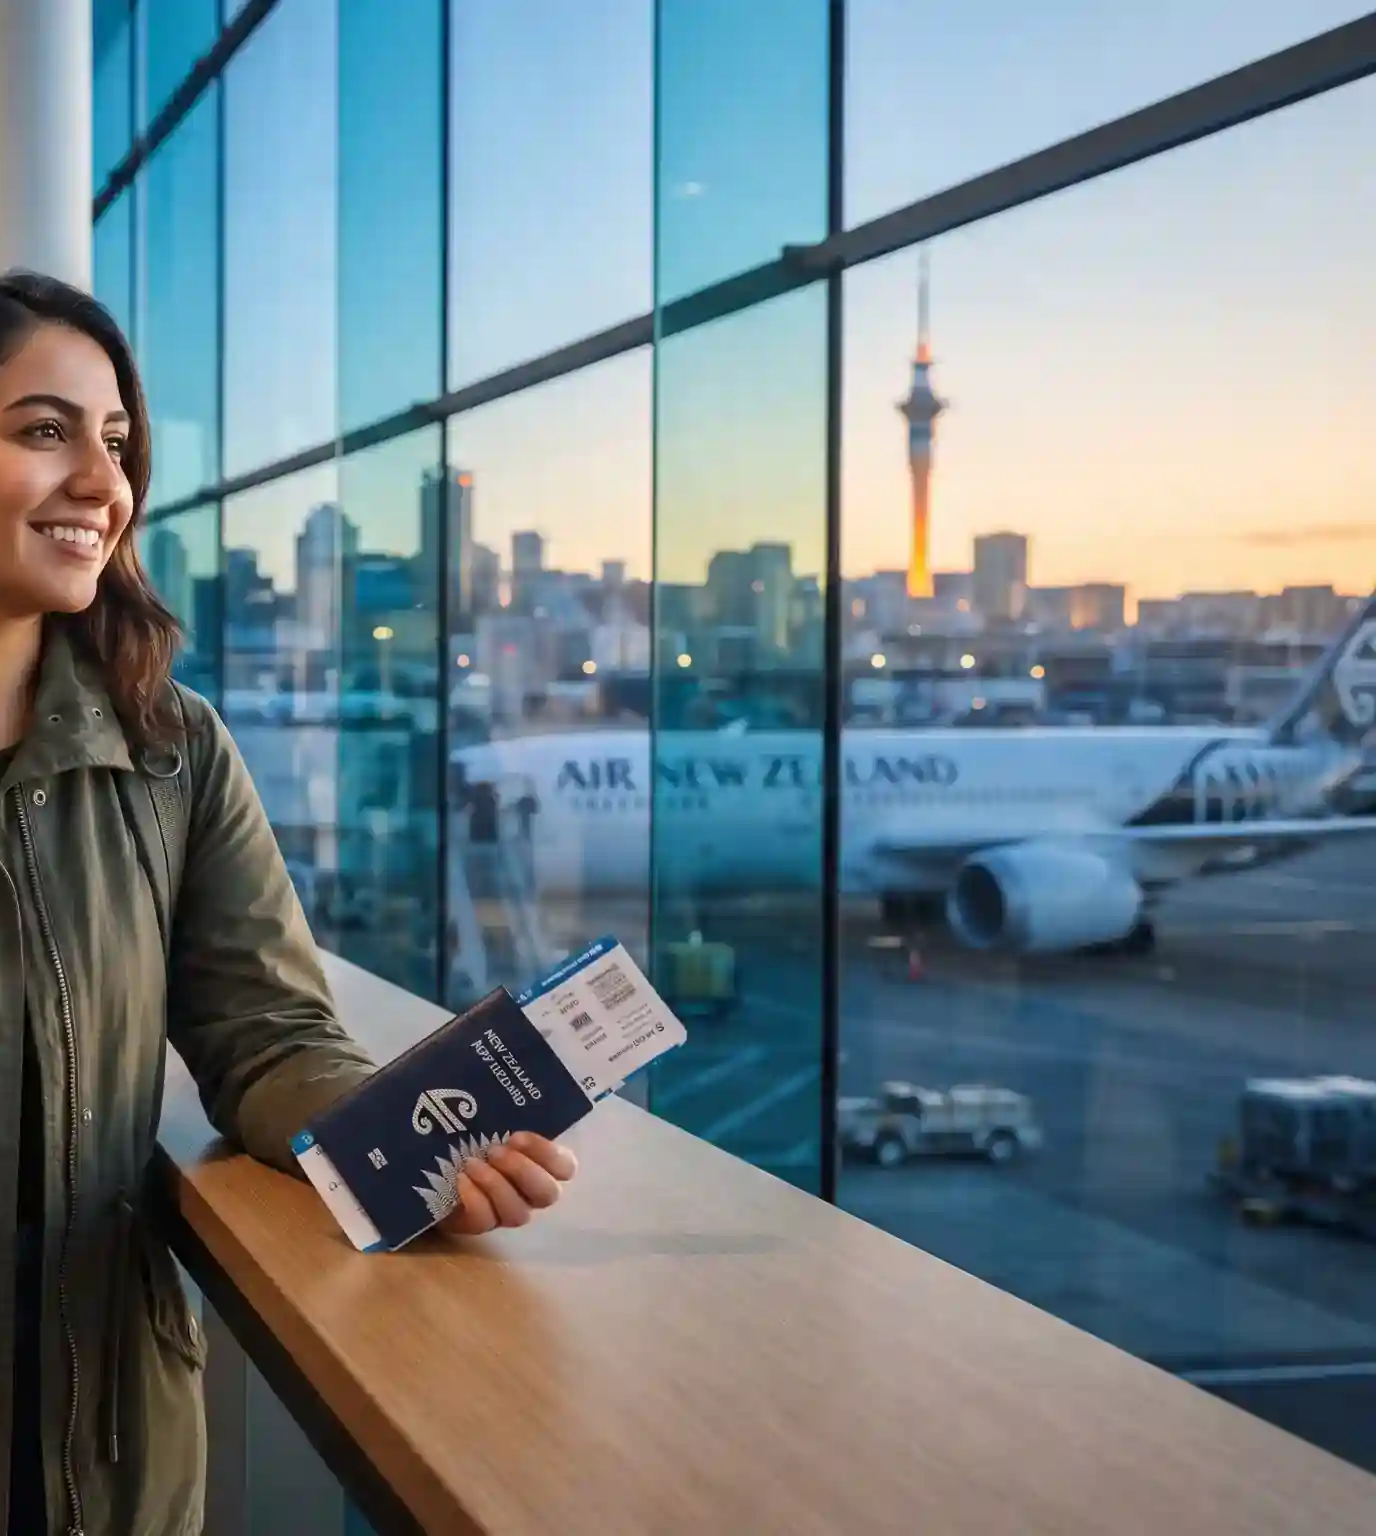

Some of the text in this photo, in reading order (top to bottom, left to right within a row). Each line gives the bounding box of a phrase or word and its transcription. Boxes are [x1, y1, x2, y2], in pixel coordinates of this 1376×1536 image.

[557, 757, 637, 791] AIR
[760, 753, 959, 788] ZELAND
[484, 1029, 542, 1100] NEW ZEALAND
